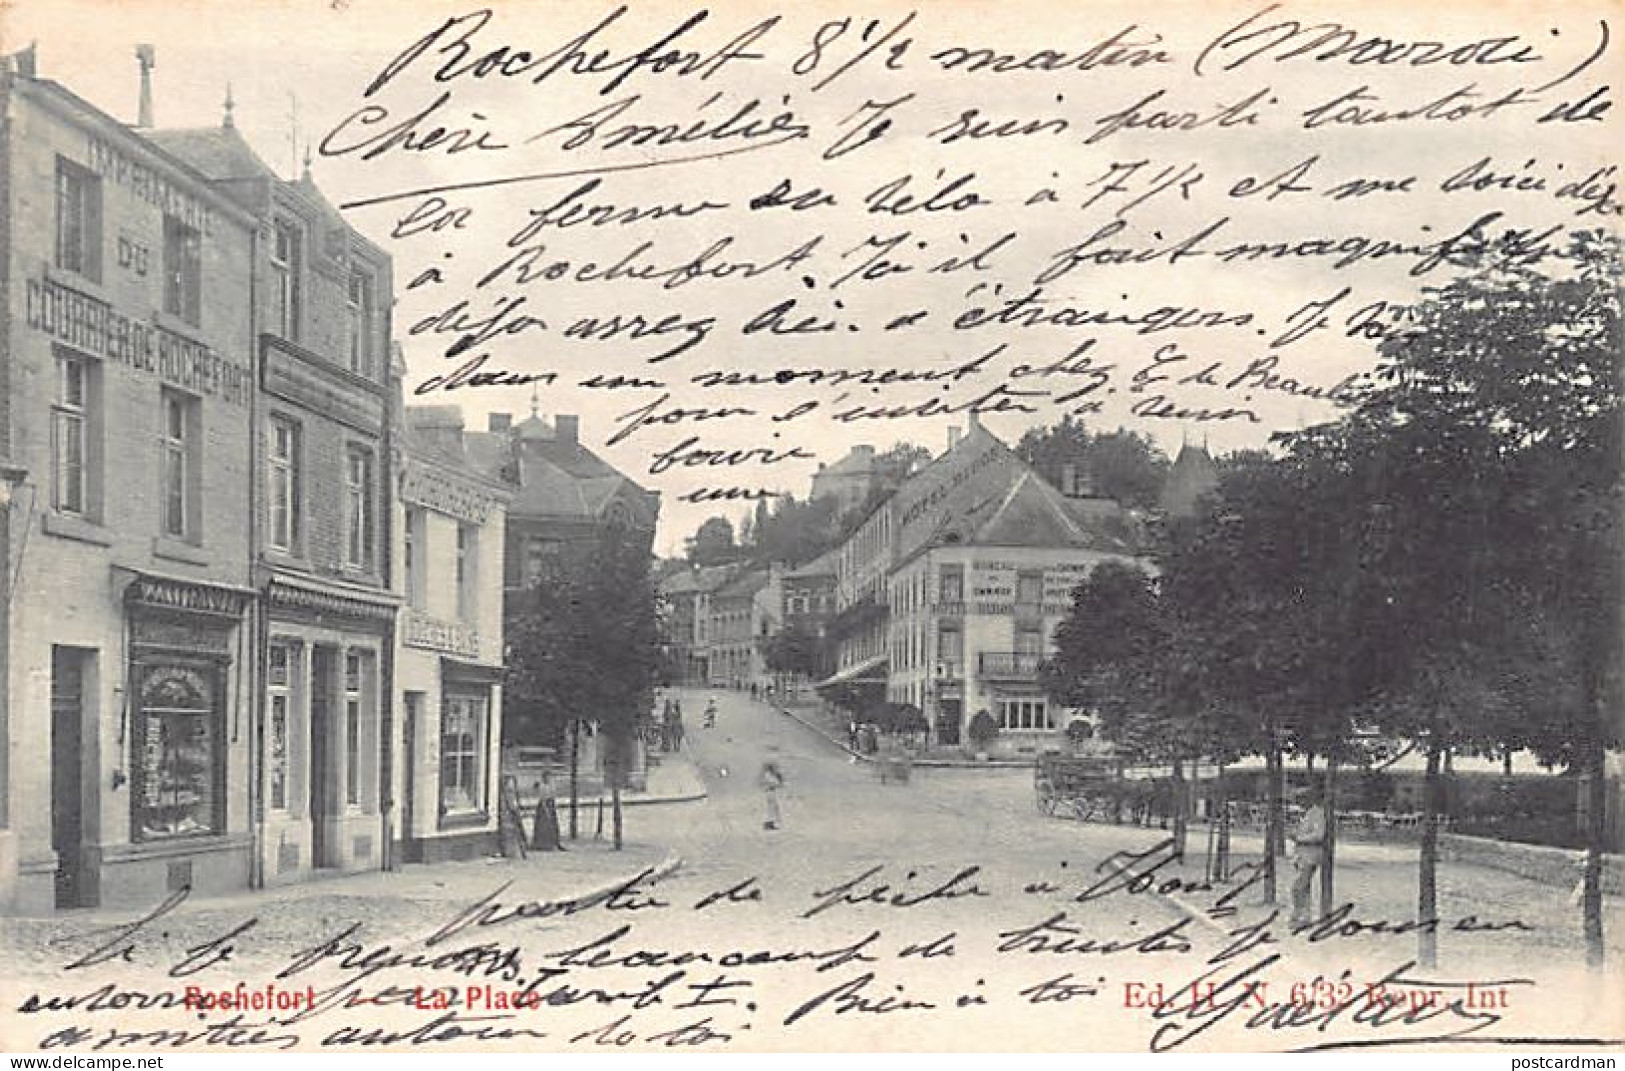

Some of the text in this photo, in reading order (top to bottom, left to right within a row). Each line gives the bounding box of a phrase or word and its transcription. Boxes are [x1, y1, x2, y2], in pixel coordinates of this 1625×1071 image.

[364, 6, 782, 96] Rochefort
[931, 24, 1175, 73] matin
[1537, 86, 1613, 124] de
